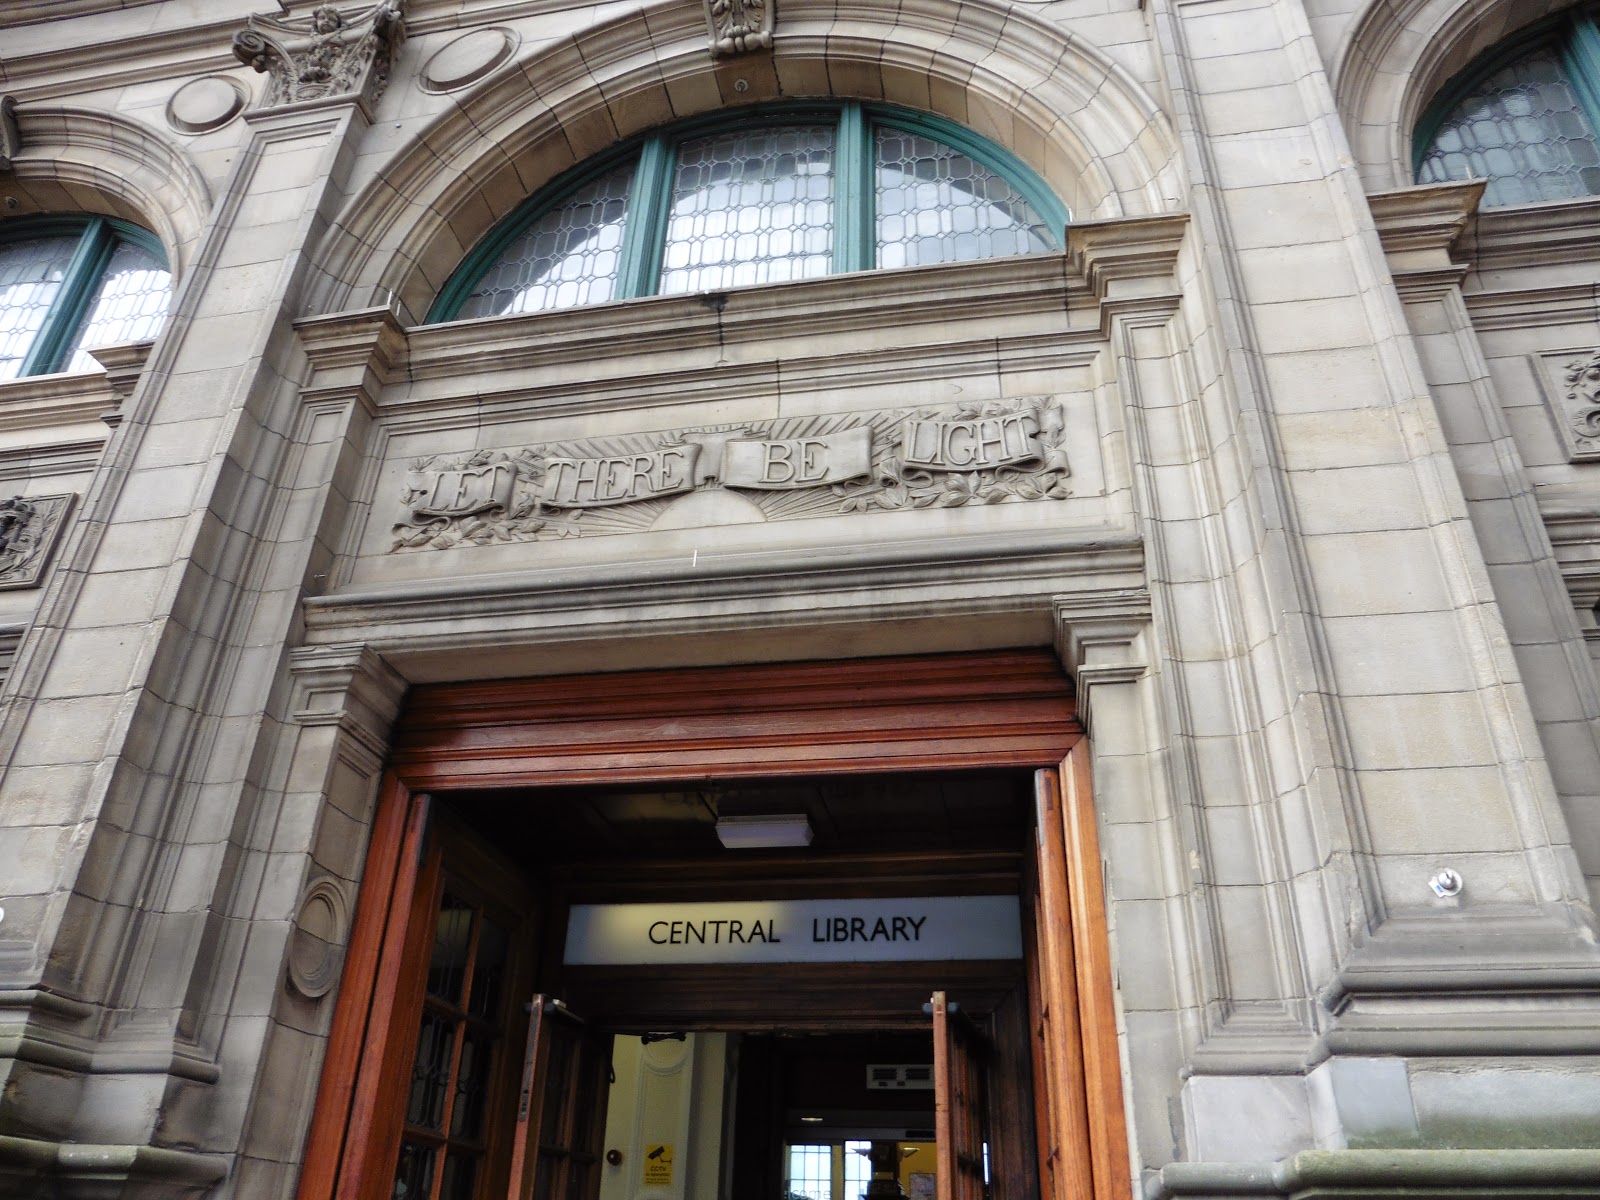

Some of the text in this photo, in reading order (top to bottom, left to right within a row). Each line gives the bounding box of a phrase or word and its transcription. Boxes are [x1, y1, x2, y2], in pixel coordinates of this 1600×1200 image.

[421, 416, 1036, 512] LET THERE BE LIGHT
[648, 916, 926, 944] CENTRAL LIBRARY
